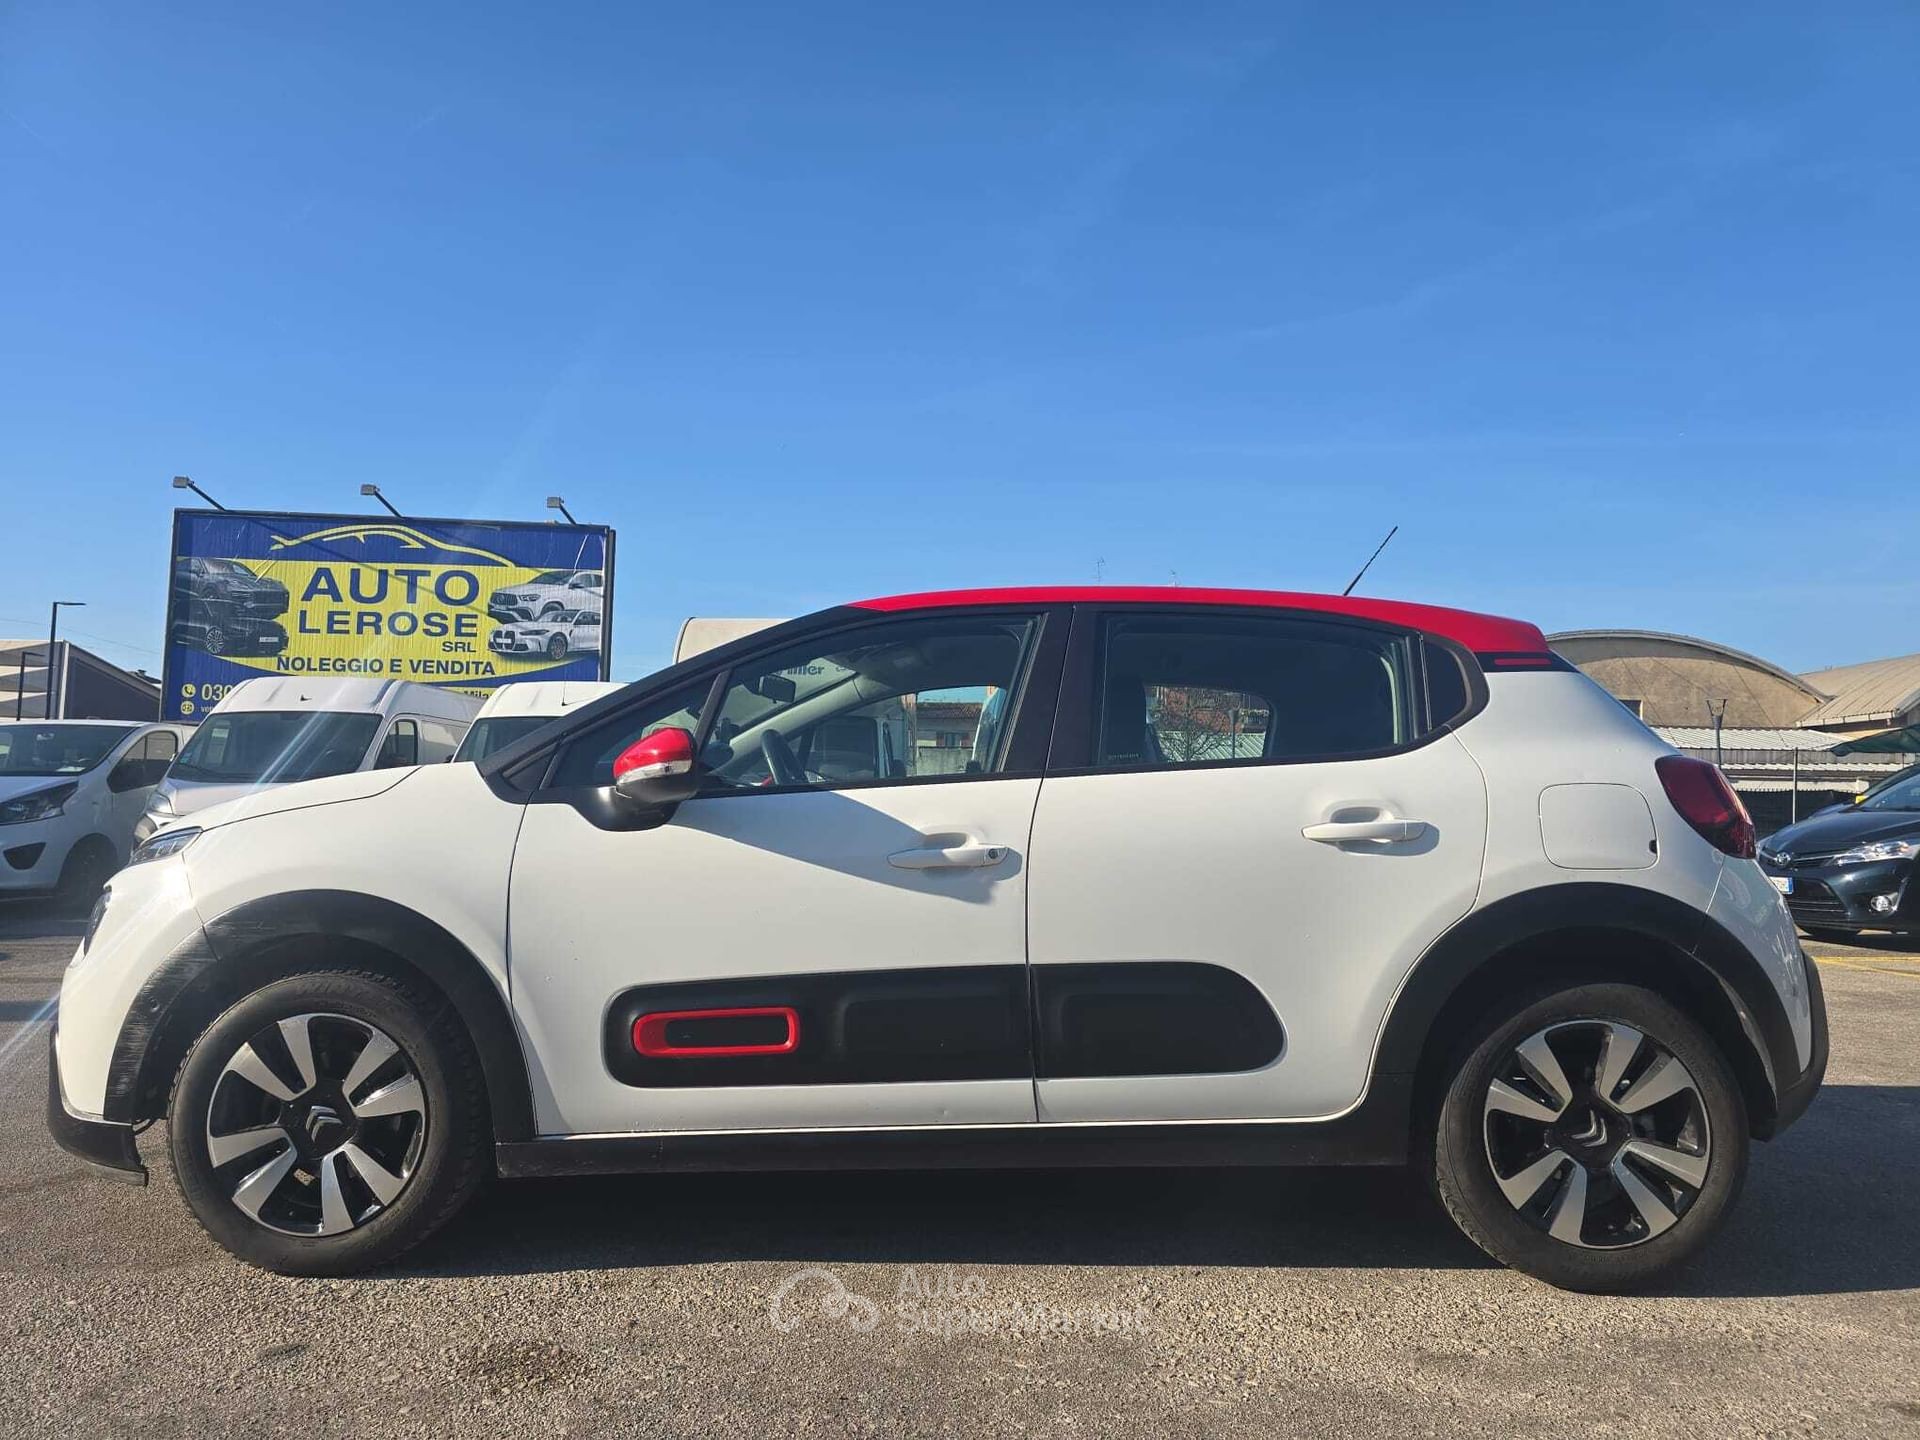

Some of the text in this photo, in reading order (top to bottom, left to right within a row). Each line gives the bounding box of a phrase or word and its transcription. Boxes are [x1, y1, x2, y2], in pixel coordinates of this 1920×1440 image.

[301, 567, 480, 606] AUTO
[299, 610, 478, 637] LEROSE
[442, 641, 476, 653] SRL
[277, 657, 496, 675] NOLEGGIO E VENDITA
